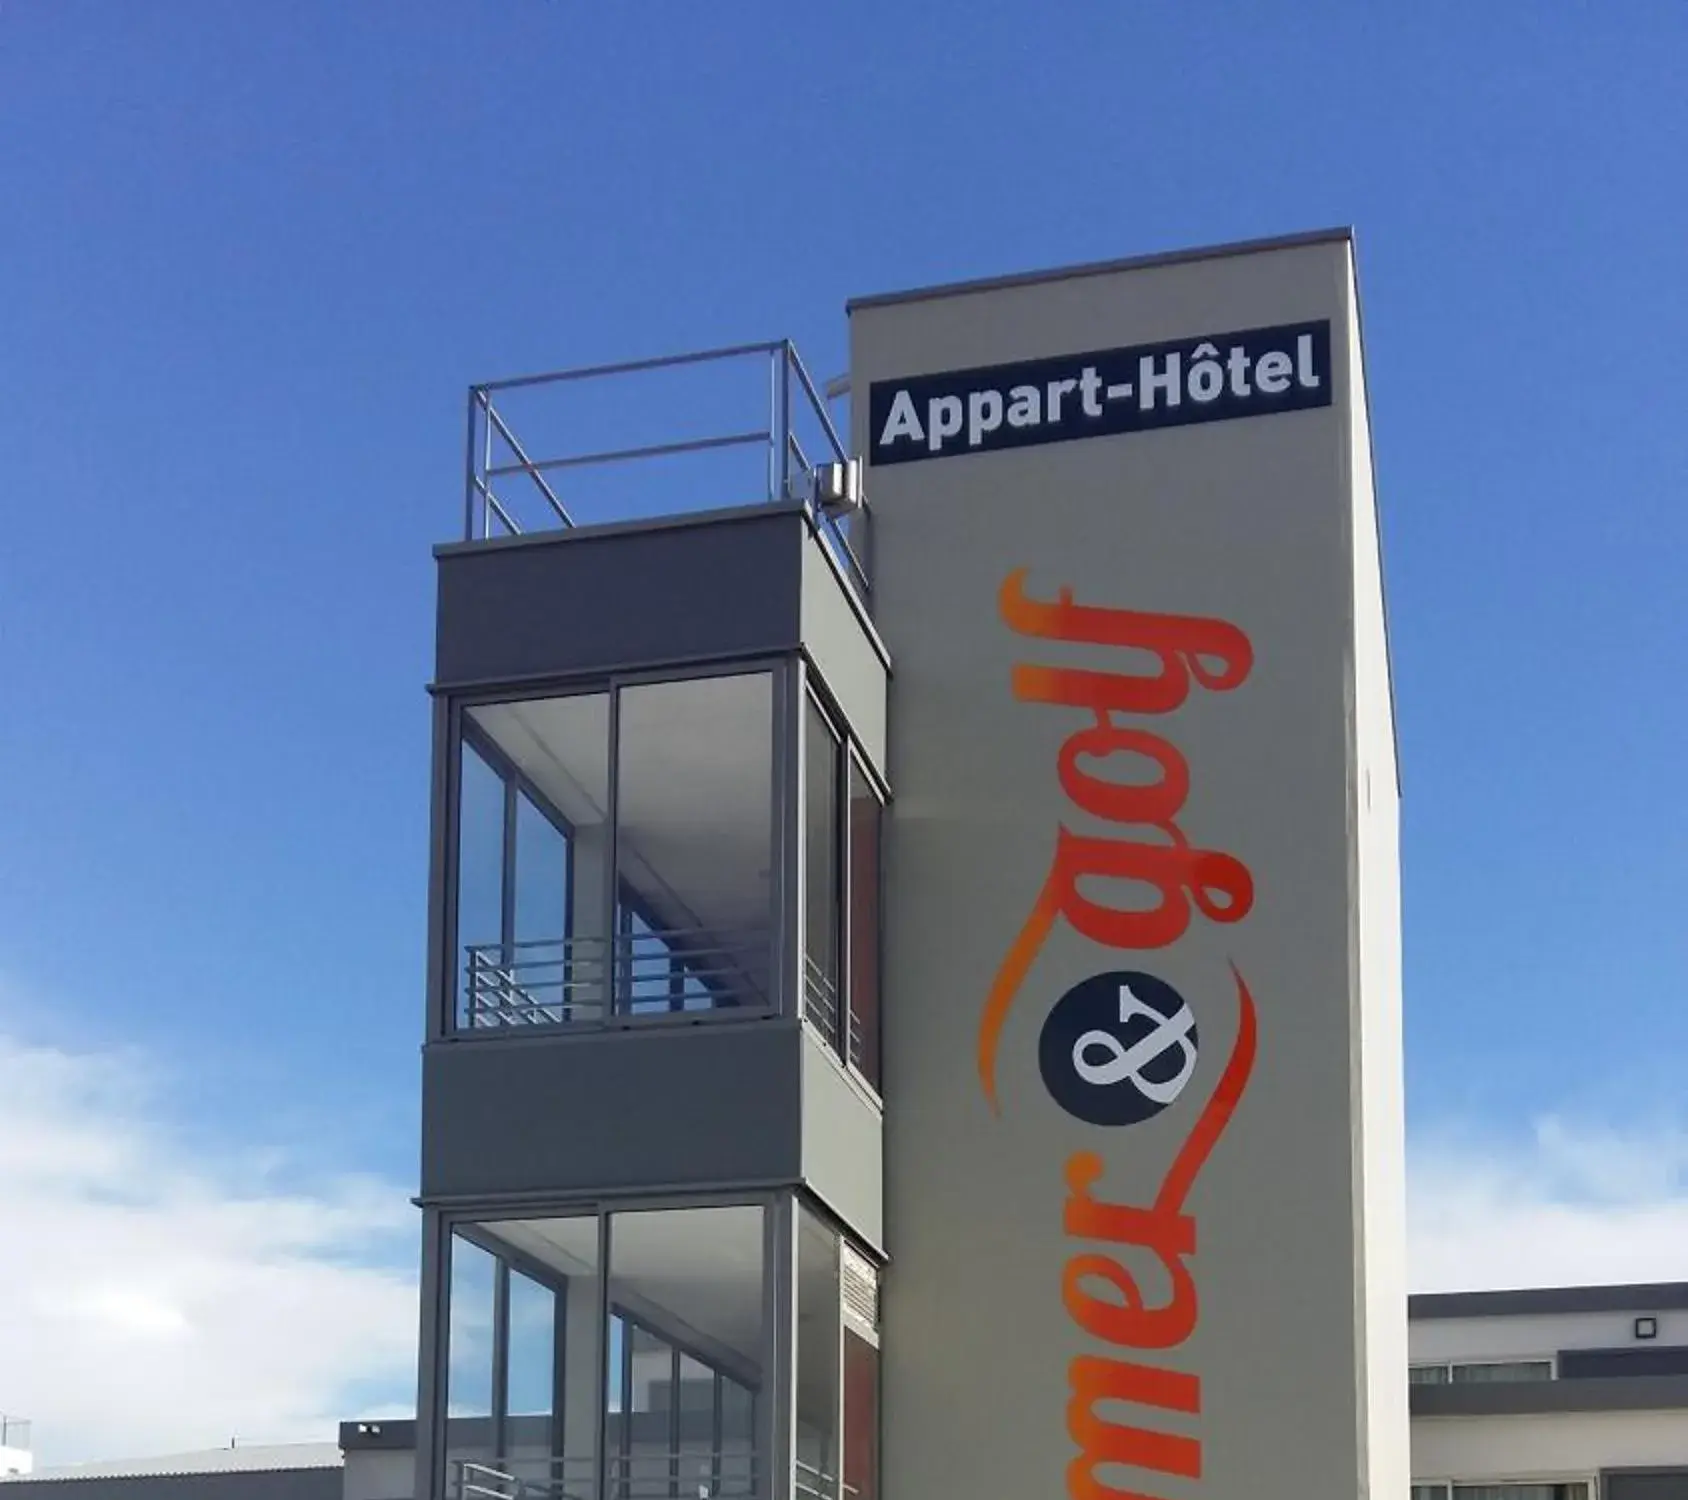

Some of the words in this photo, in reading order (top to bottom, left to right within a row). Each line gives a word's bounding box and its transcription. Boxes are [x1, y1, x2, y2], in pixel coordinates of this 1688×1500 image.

[879, 335, 1320, 451] Appart-Hôtel
[979, 567, 1254, 1120] golf
[1072, 984, 1198, 1104] &
